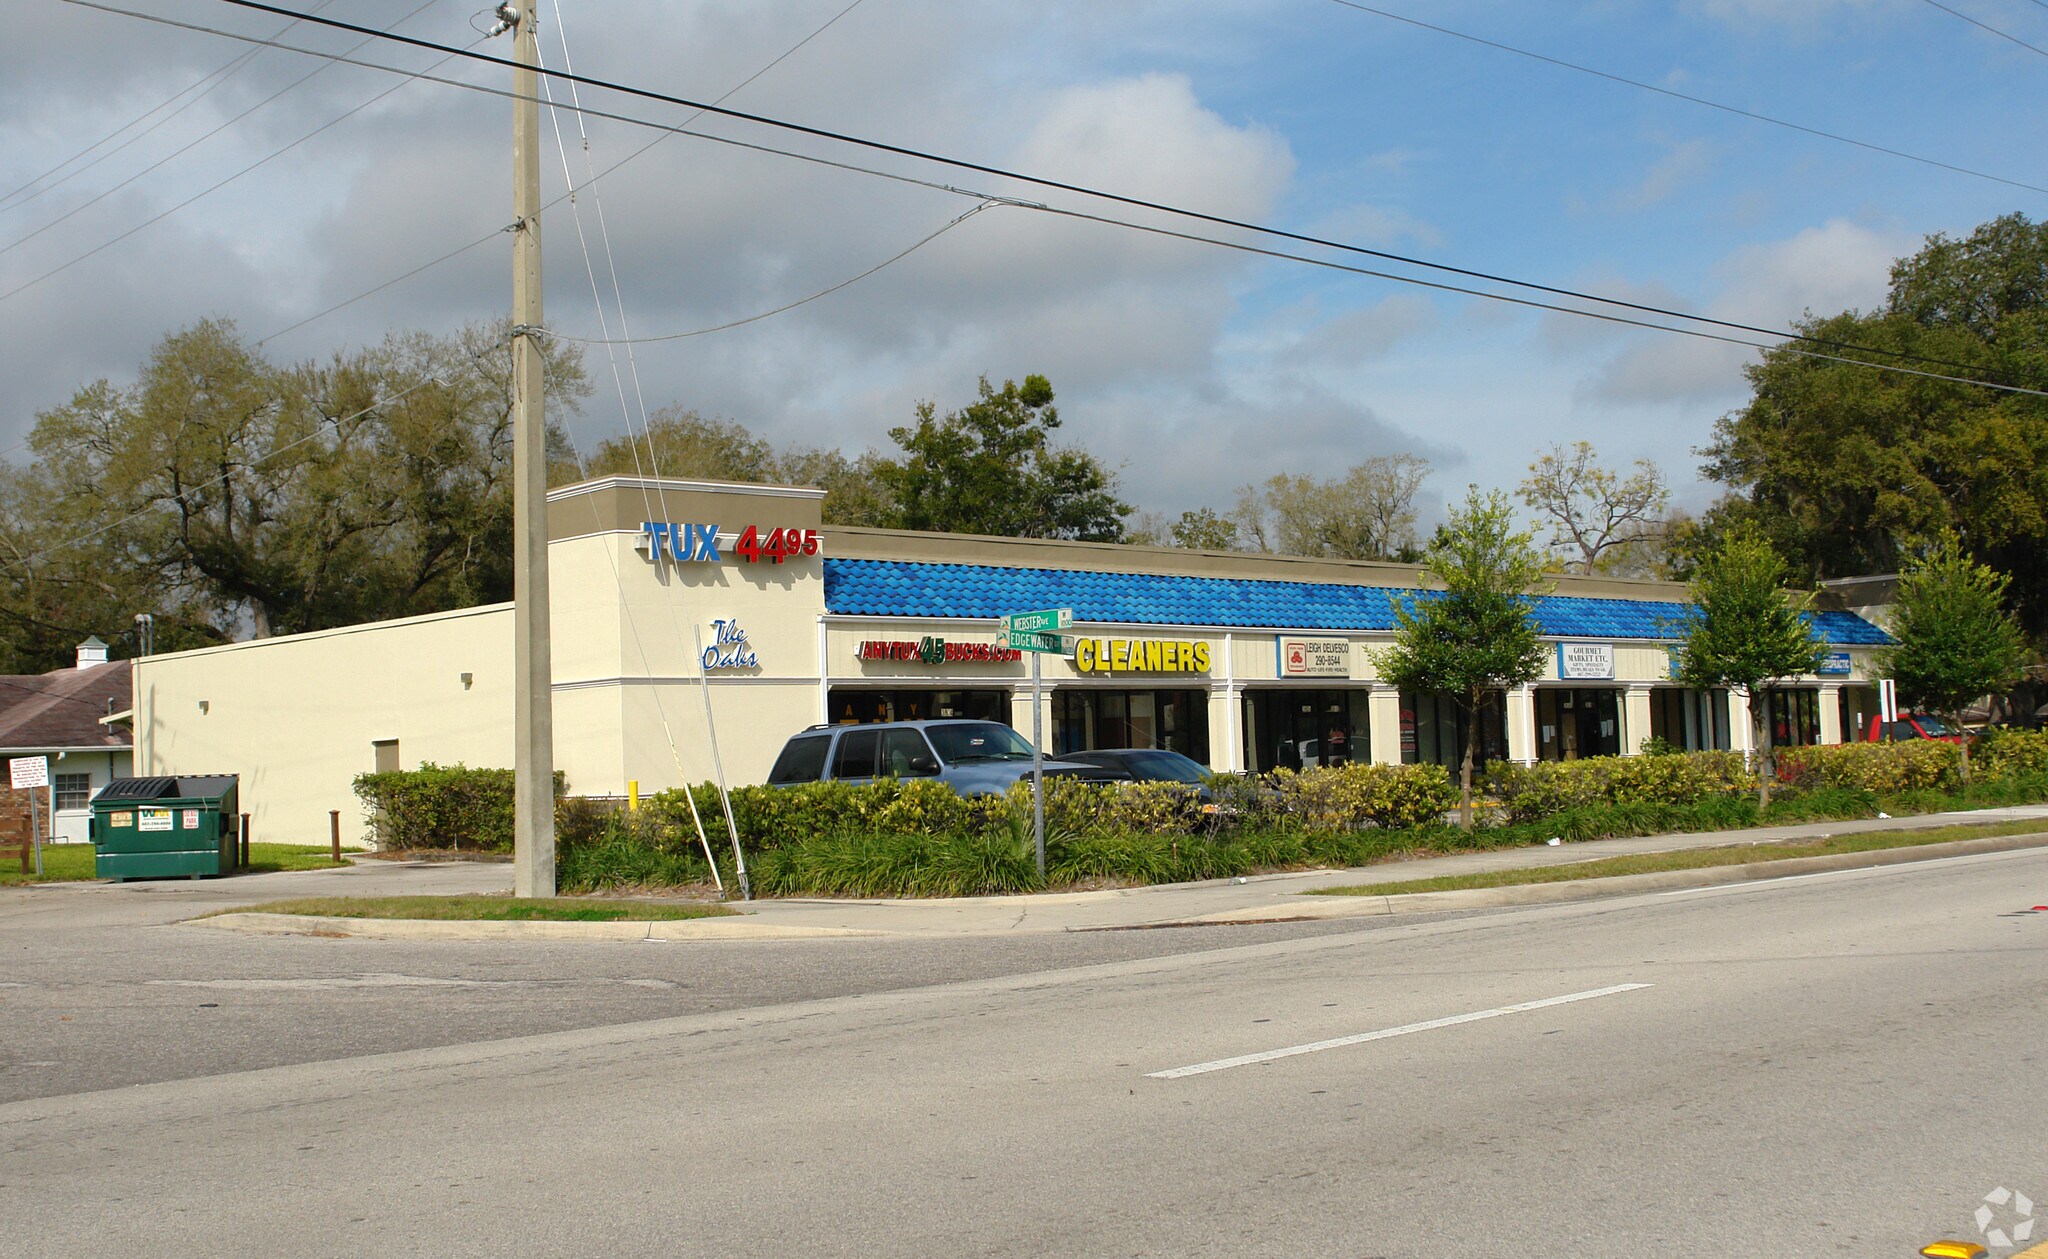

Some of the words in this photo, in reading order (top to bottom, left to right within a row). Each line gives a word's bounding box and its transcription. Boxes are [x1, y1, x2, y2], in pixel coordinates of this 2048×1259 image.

[642, 522, 721, 561] TUX
[713, 618, 748, 645] The
[1013, 616, 1041, 630] WEBSTER
[1010, 633, 1054, 650] EDGEWATER
[1306, 642, 1322, 653] LEIGH
[1323, 643, 1349, 654] DELVESCO
[702, 645, 760, 670] Oaks
[1076, 638, 1211, 672] CLEANERS
[1568, 655, 1594, 663] MARKET
[1595, 655, 1609, 663] ETC.
[1573, 647, 1602, 655] GOURMET
